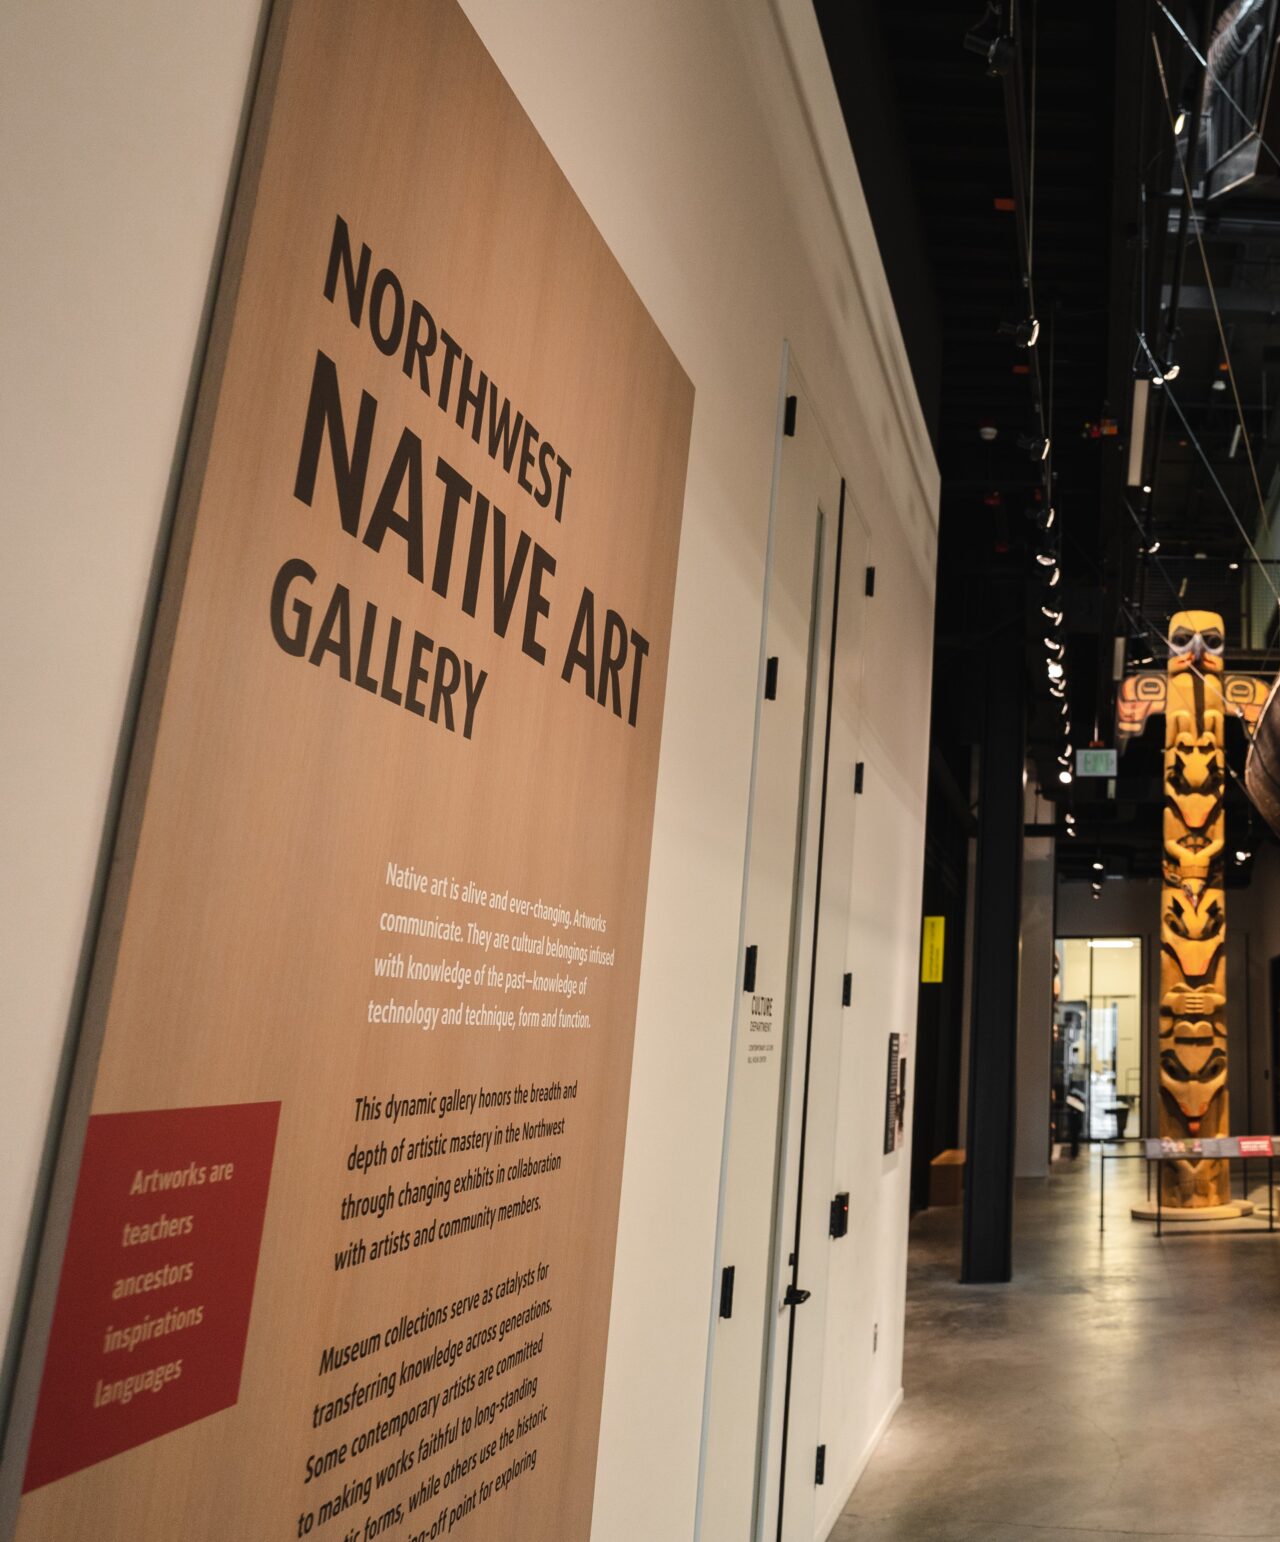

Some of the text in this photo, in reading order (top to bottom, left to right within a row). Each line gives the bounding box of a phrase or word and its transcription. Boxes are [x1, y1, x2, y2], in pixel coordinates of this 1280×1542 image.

[323, 213, 572, 523] NORTHWEST
[293, 348, 650, 728] NATIVE ART
[269, 558, 488, 740] GALLERY
[385, 862, 606, 932] Native art is alive and ever-changing. Artworks
[375, 953, 403, 978] with
[407, 955, 471, 989] knowledge
[474, 964, 486, 986] of
[488, 965, 503, 987] the
[579, 976, 587, 995] of
[380, 913, 615, 966] communicate. They are cultural belongings infused
[367, 998, 591, 1031] technology and technique, form and function.
[355, 1080, 578, 1124] This dynamic gallery honors the breadth and
[130, 1161, 234, 1196] Artworks are
[347, 1118, 565, 1174] depth of artistic mastery in the Northwest
[340, 1152, 562, 1221] through changing exhibits in collaboration
[122, 1213, 194, 1248] teachers
[334, 1194, 541, 1271] with artists and community members.
[111, 1261, 194, 1300] ancestors
[103, 1304, 204, 1354] inspirations
[318, 1261, 549, 1377] Museum collections serve as catalysts for
[93, 1359, 183, 1409] languages
[312, 1299, 552, 1429] transferring knowledge across generations.
[304, 1331, 544, 1484] Some contemporary artists are committed
[297, 1377, 538, 1539] to making works faithful to long-standing
[364, 1404, 548, 1542] forms, while others use the historic
[448, 1489, 477, 1533] point
[479, 1481, 494, 1504] for
[495, 1449, 537, 1492] exploring
